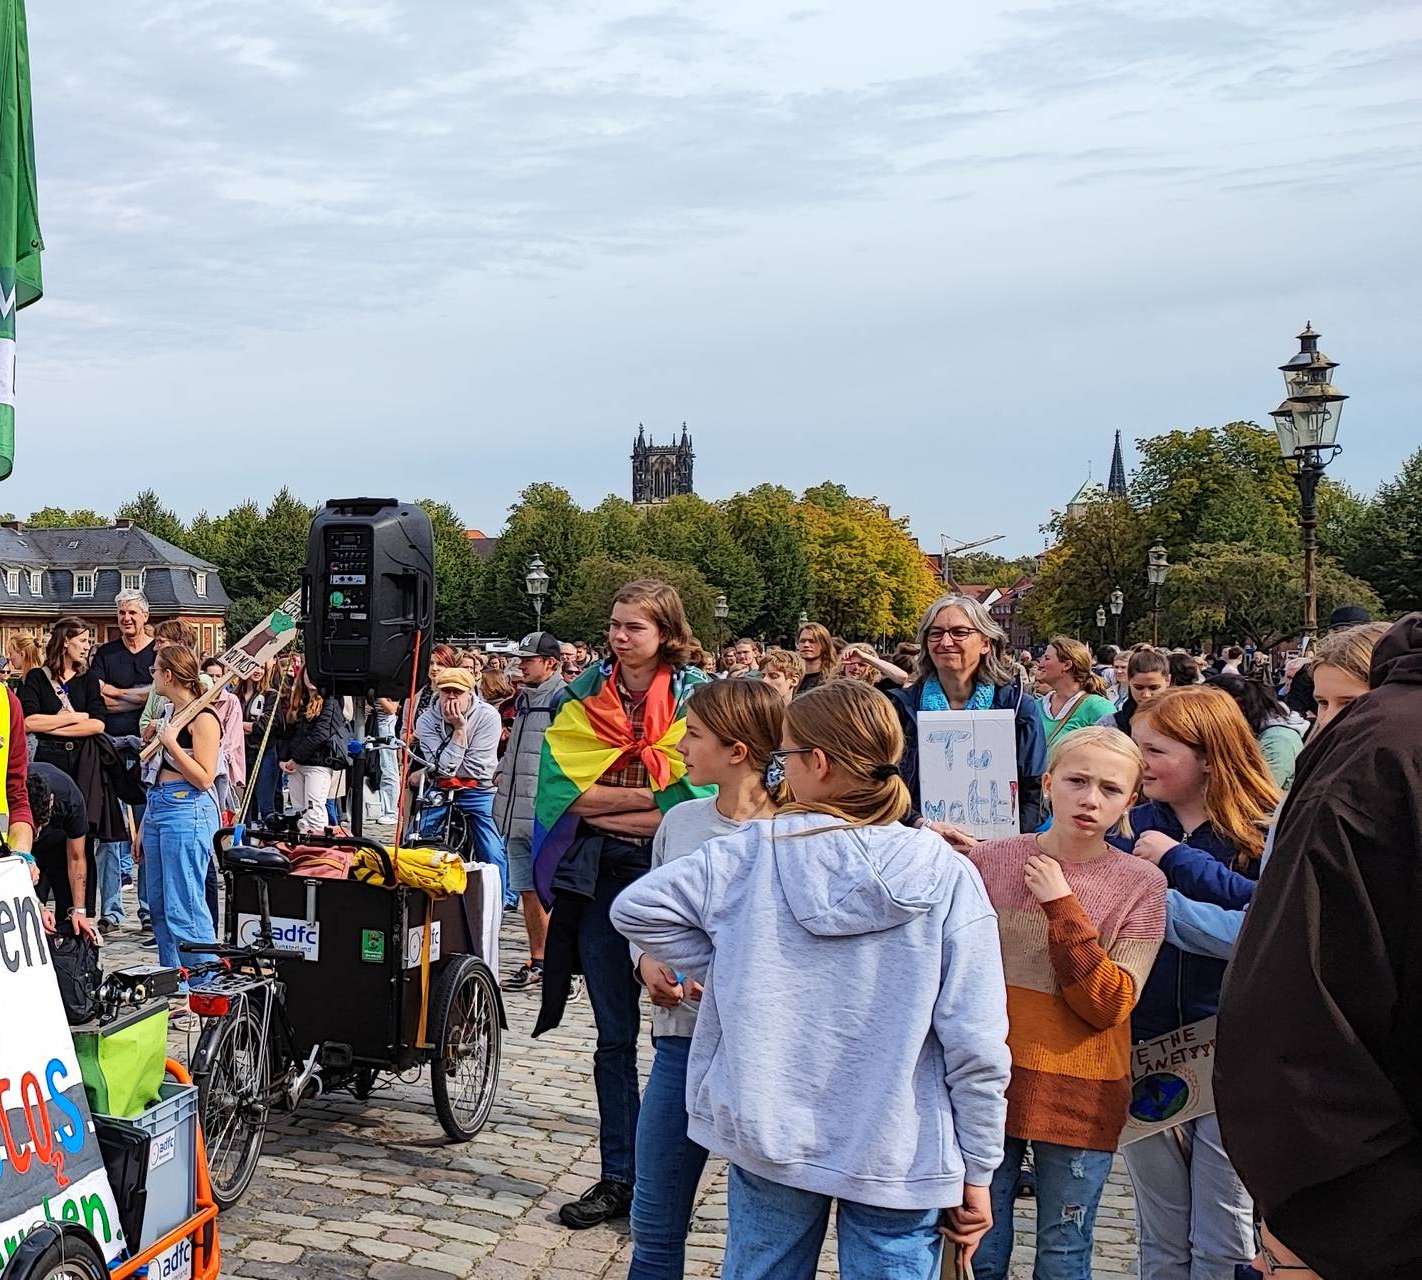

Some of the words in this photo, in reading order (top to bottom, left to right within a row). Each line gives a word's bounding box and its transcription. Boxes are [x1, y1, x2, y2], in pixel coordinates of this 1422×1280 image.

[233, 655, 260, 676] MUST
[924, 779, 1018, 826] watt!
[271, 924, 317, 945] adfc
[1149, 1027, 1196, 1054] THE
[159, 1135, 174, 1152] adfc
[163, 1241, 190, 1277] adfc
